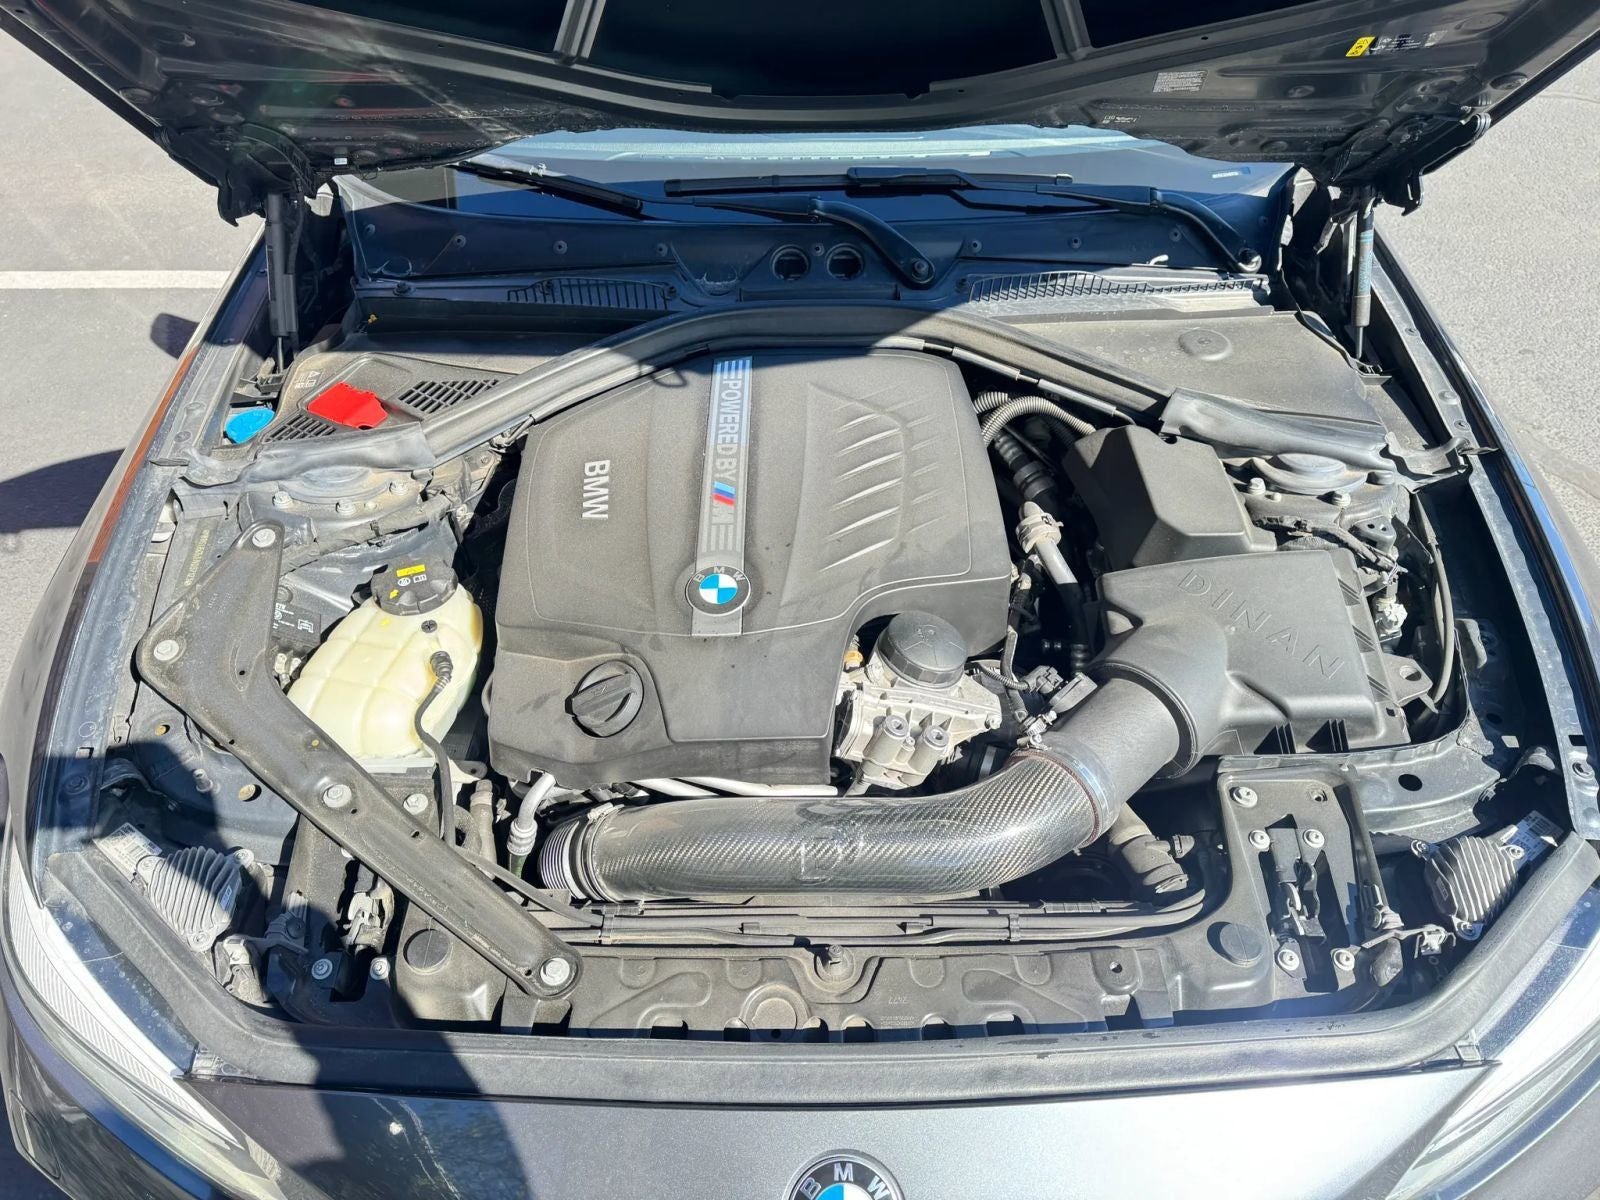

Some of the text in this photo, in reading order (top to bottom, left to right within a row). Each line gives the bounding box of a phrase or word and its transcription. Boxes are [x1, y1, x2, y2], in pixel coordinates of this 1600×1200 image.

[717, 379, 742, 456] POWERED
[582, 459, 611, 518] BMW
[714, 458, 738, 481] BY
[693, 566, 746, 583] BMW
[1177, 568, 1346, 680] DINAN
[800, 1162, 891, 1200] BMW
